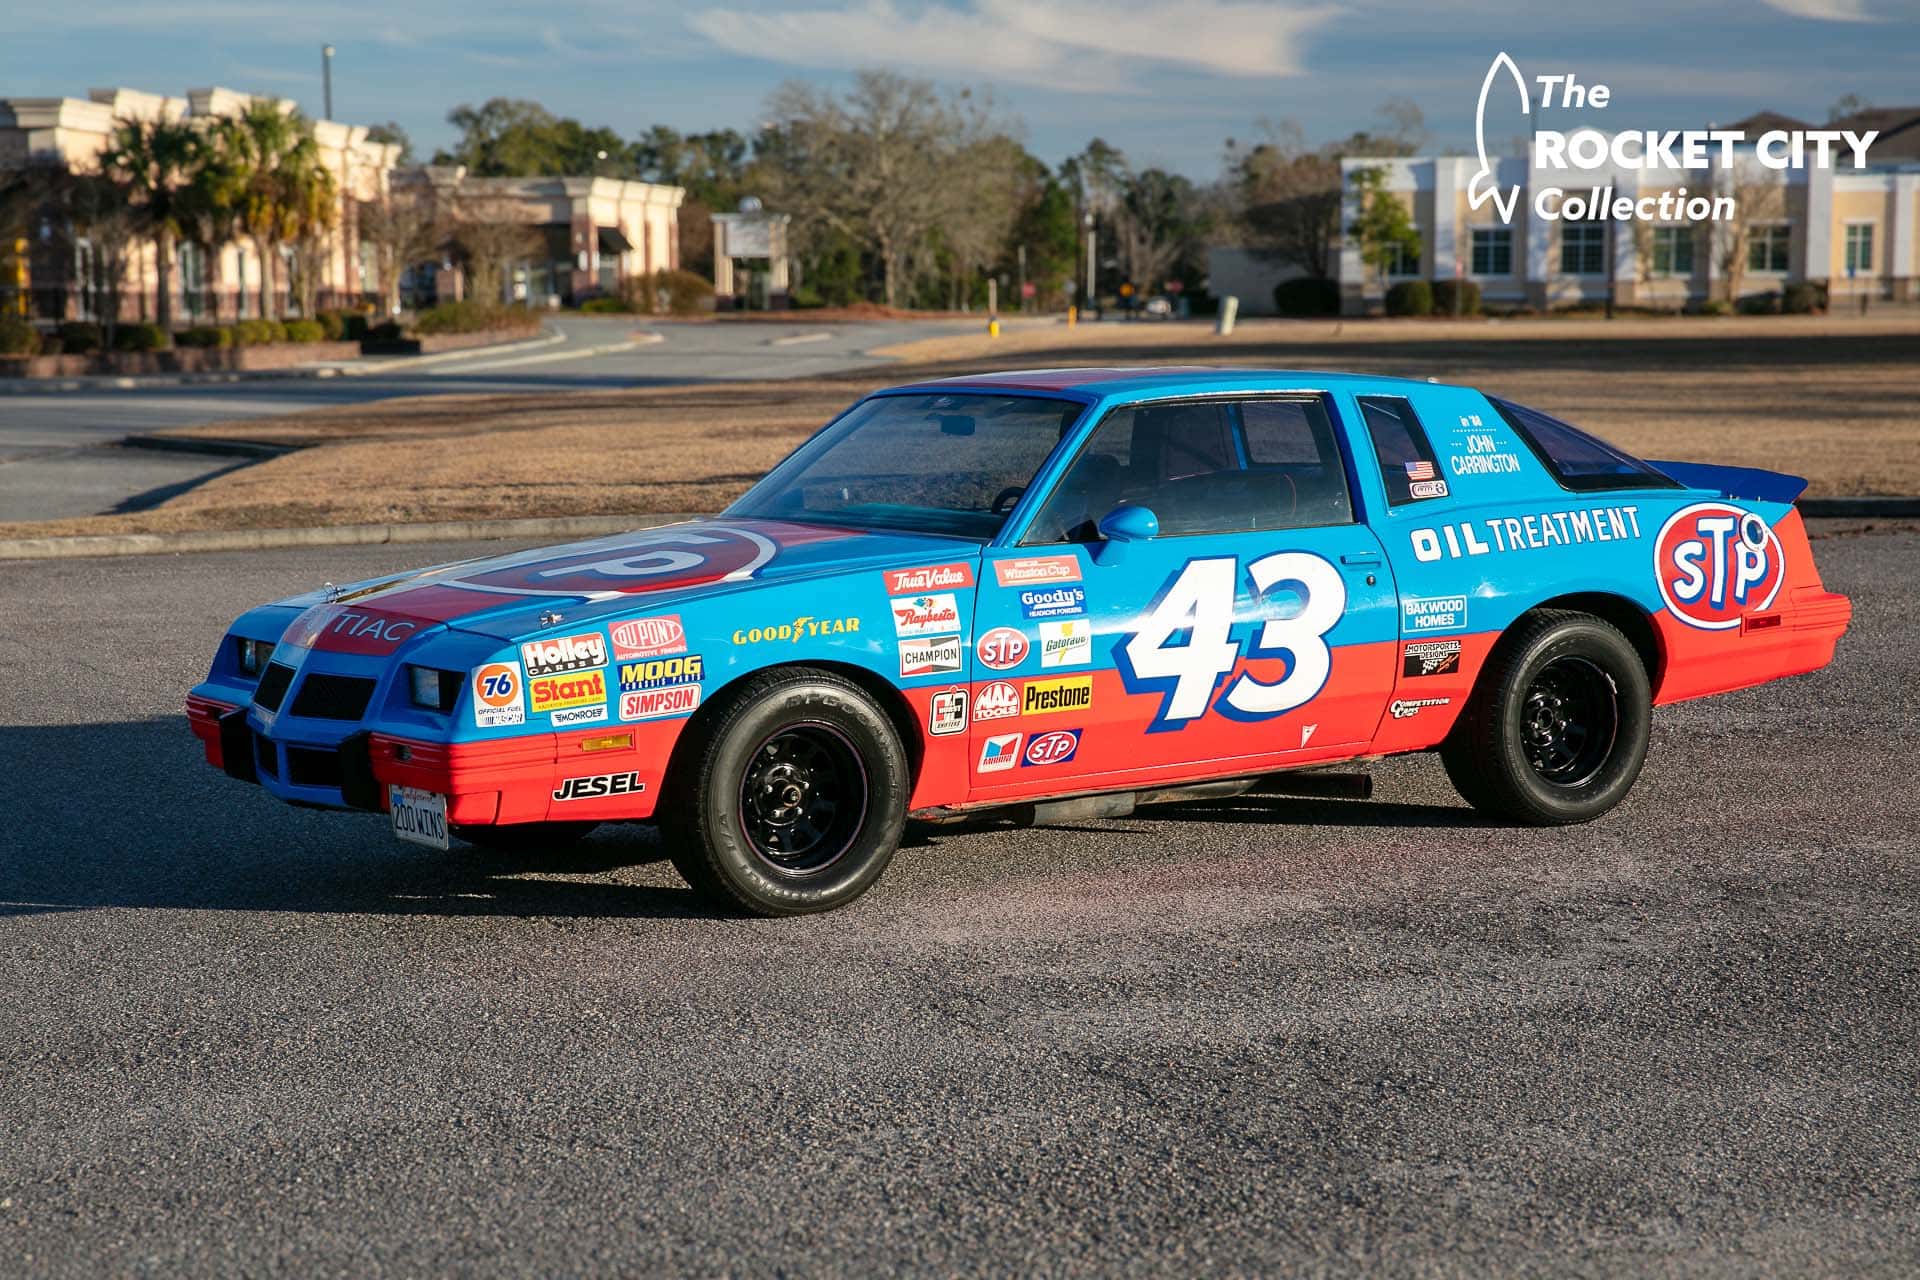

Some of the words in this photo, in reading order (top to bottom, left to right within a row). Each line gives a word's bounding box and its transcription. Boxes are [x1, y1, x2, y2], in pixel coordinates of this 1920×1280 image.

[1466, 434, 1497, 454] JOHN
[1450, 454, 1521, 475] CARRINGTON
[1410, 522, 1489, 562] OIL
[1486, 506, 1641, 553] TREATMENT
[1048, 565, 1071, 578] Cup
[1673, 516, 1770, 609] STP
[893, 570, 925, 592] True
[917, 567, 965, 589] Value
[1021, 588, 1084, 605] Goody's
[1406, 599, 1463, 616] OAKWOOD
[1415, 614, 1455, 628] HOMES
[523, 639, 606, 668] Holley
[983, 632, 1023, 664] STP
[1113, 550, 1346, 731] 43
[1408, 641, 1459, 653] MOTORSPORTS
[529, 661, 586, 676] CARBS
[621, 655, 702, 684] MOOG
[905, 648, 957, 665] CHAMPION
[484, 672, 512, 698] 76
[533, 674, 603, 703] Stant
[978, 684, 1017, 710] MAC
[1025, 685, 1090, 711] Prestone
[626, 688, 694, 715] SIMPSON
[976, 706, 1018, 719] TOOLS
[558, 708, 601, 722] MONROE
[1031, 735, 1070, 763] STP
[554, 773, 645, 800] JESEL
